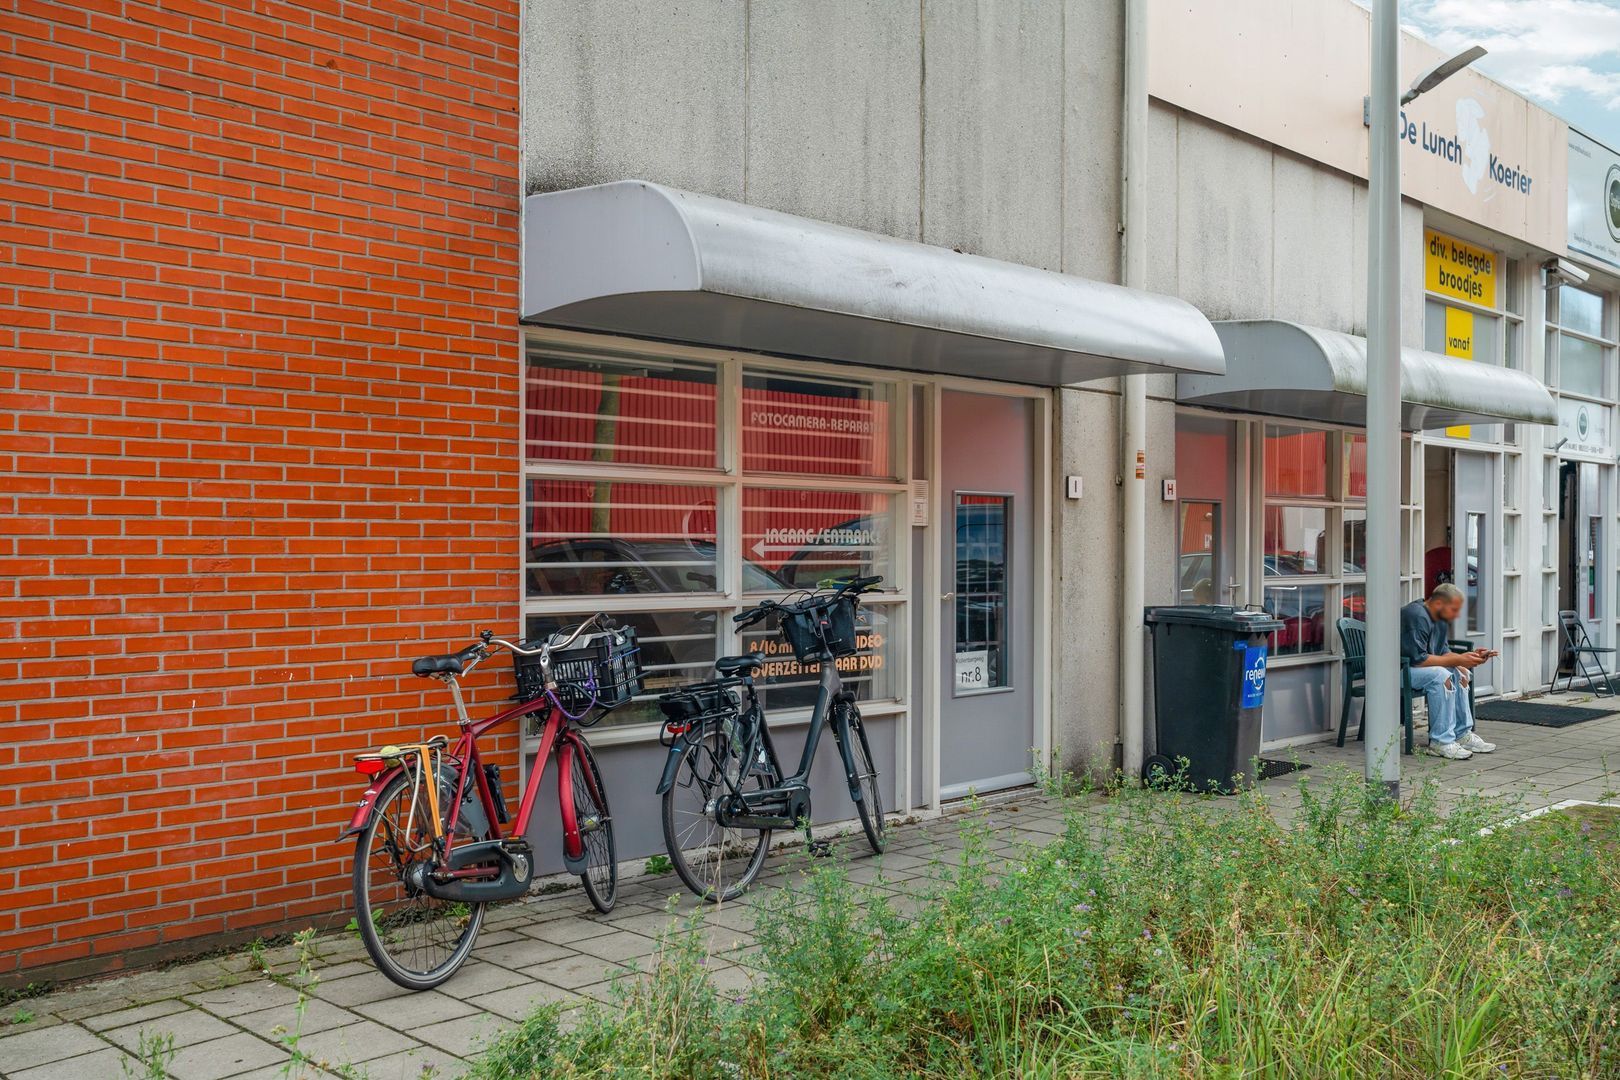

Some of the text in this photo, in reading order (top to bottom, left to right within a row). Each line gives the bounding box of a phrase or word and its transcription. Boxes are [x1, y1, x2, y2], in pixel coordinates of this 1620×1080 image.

[1400, 111, 1532, 196] De Lunch Koerier
[1429, 236, 1492, 276] div. belegde
[1439, 264, 1483, 299] broodjes
[1448, 335, 1470, 352] vanaf
[1167, 483, 1174, 496] H
[779, 643, 793, 654] m
[856, 634, 882, 649] IDEO
[834, 657, 857, 672] AAR
[860, 655, 883, 670] DVD
[1245, 668, 1266, 682] renew
